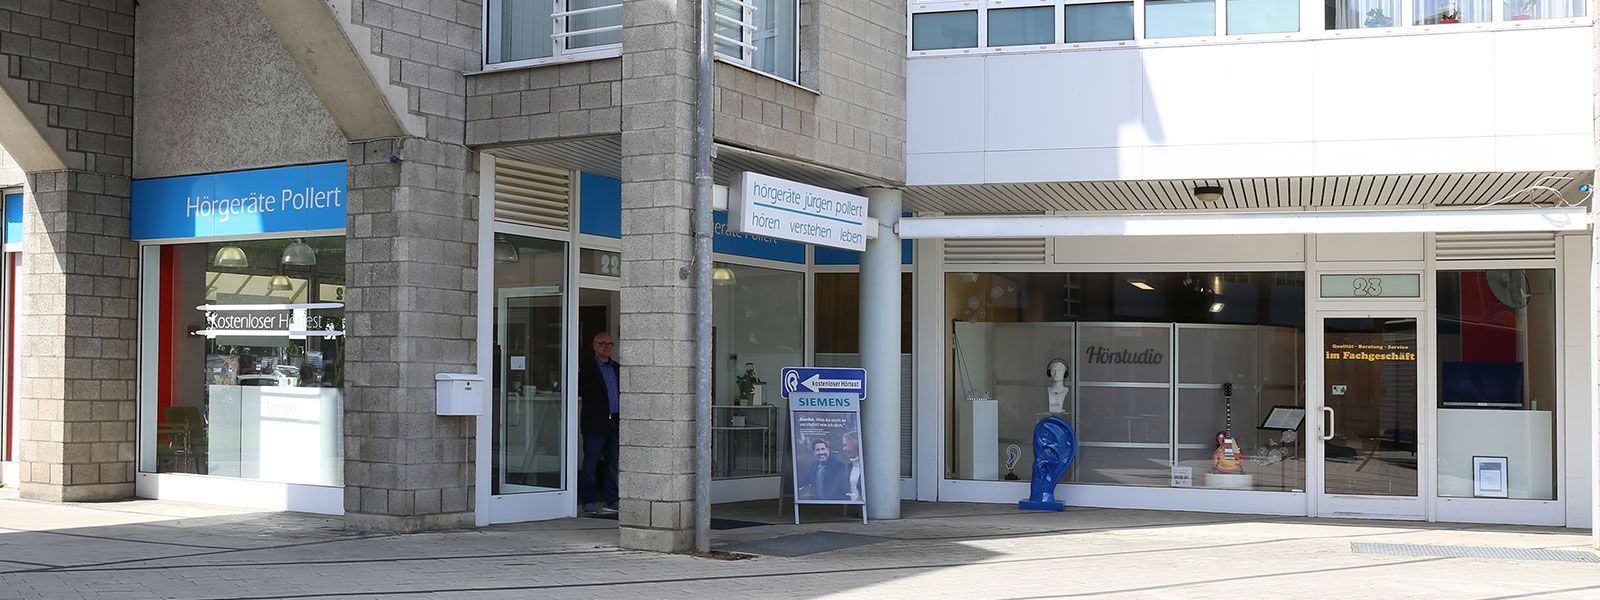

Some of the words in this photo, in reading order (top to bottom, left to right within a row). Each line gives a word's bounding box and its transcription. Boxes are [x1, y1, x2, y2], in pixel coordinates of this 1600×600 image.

[186, 191, 276, 222] Hörgeräte
[281, 187, 341, 211] Pollert
[753, 181, 801, 205] hörgeräte
[802, 192, 833, 213] jürgen
[835, 200, 863, 217] pollert
[752, 212, 781, 230] hören
[790, 223, 832, 239] verstehen
[840, 227, 862, 244] leben
[601, 254, 620, 274] 22
[1353, 277, 1382, 297] 23
[212, 313, 277, 329] Kostenloser
[278, 313, 323, 330] Höest
[1086, 346, 1164, 365] Hörstudio
[1325, 351, 1340, 360] im
[1343, 351, 1416, 362] Fachgeschäft
[812, 380, 840, 388] kostenloser
[841, 380, 859, 388] Hörtest
[799, 397, 851, 407] SIEMENS
